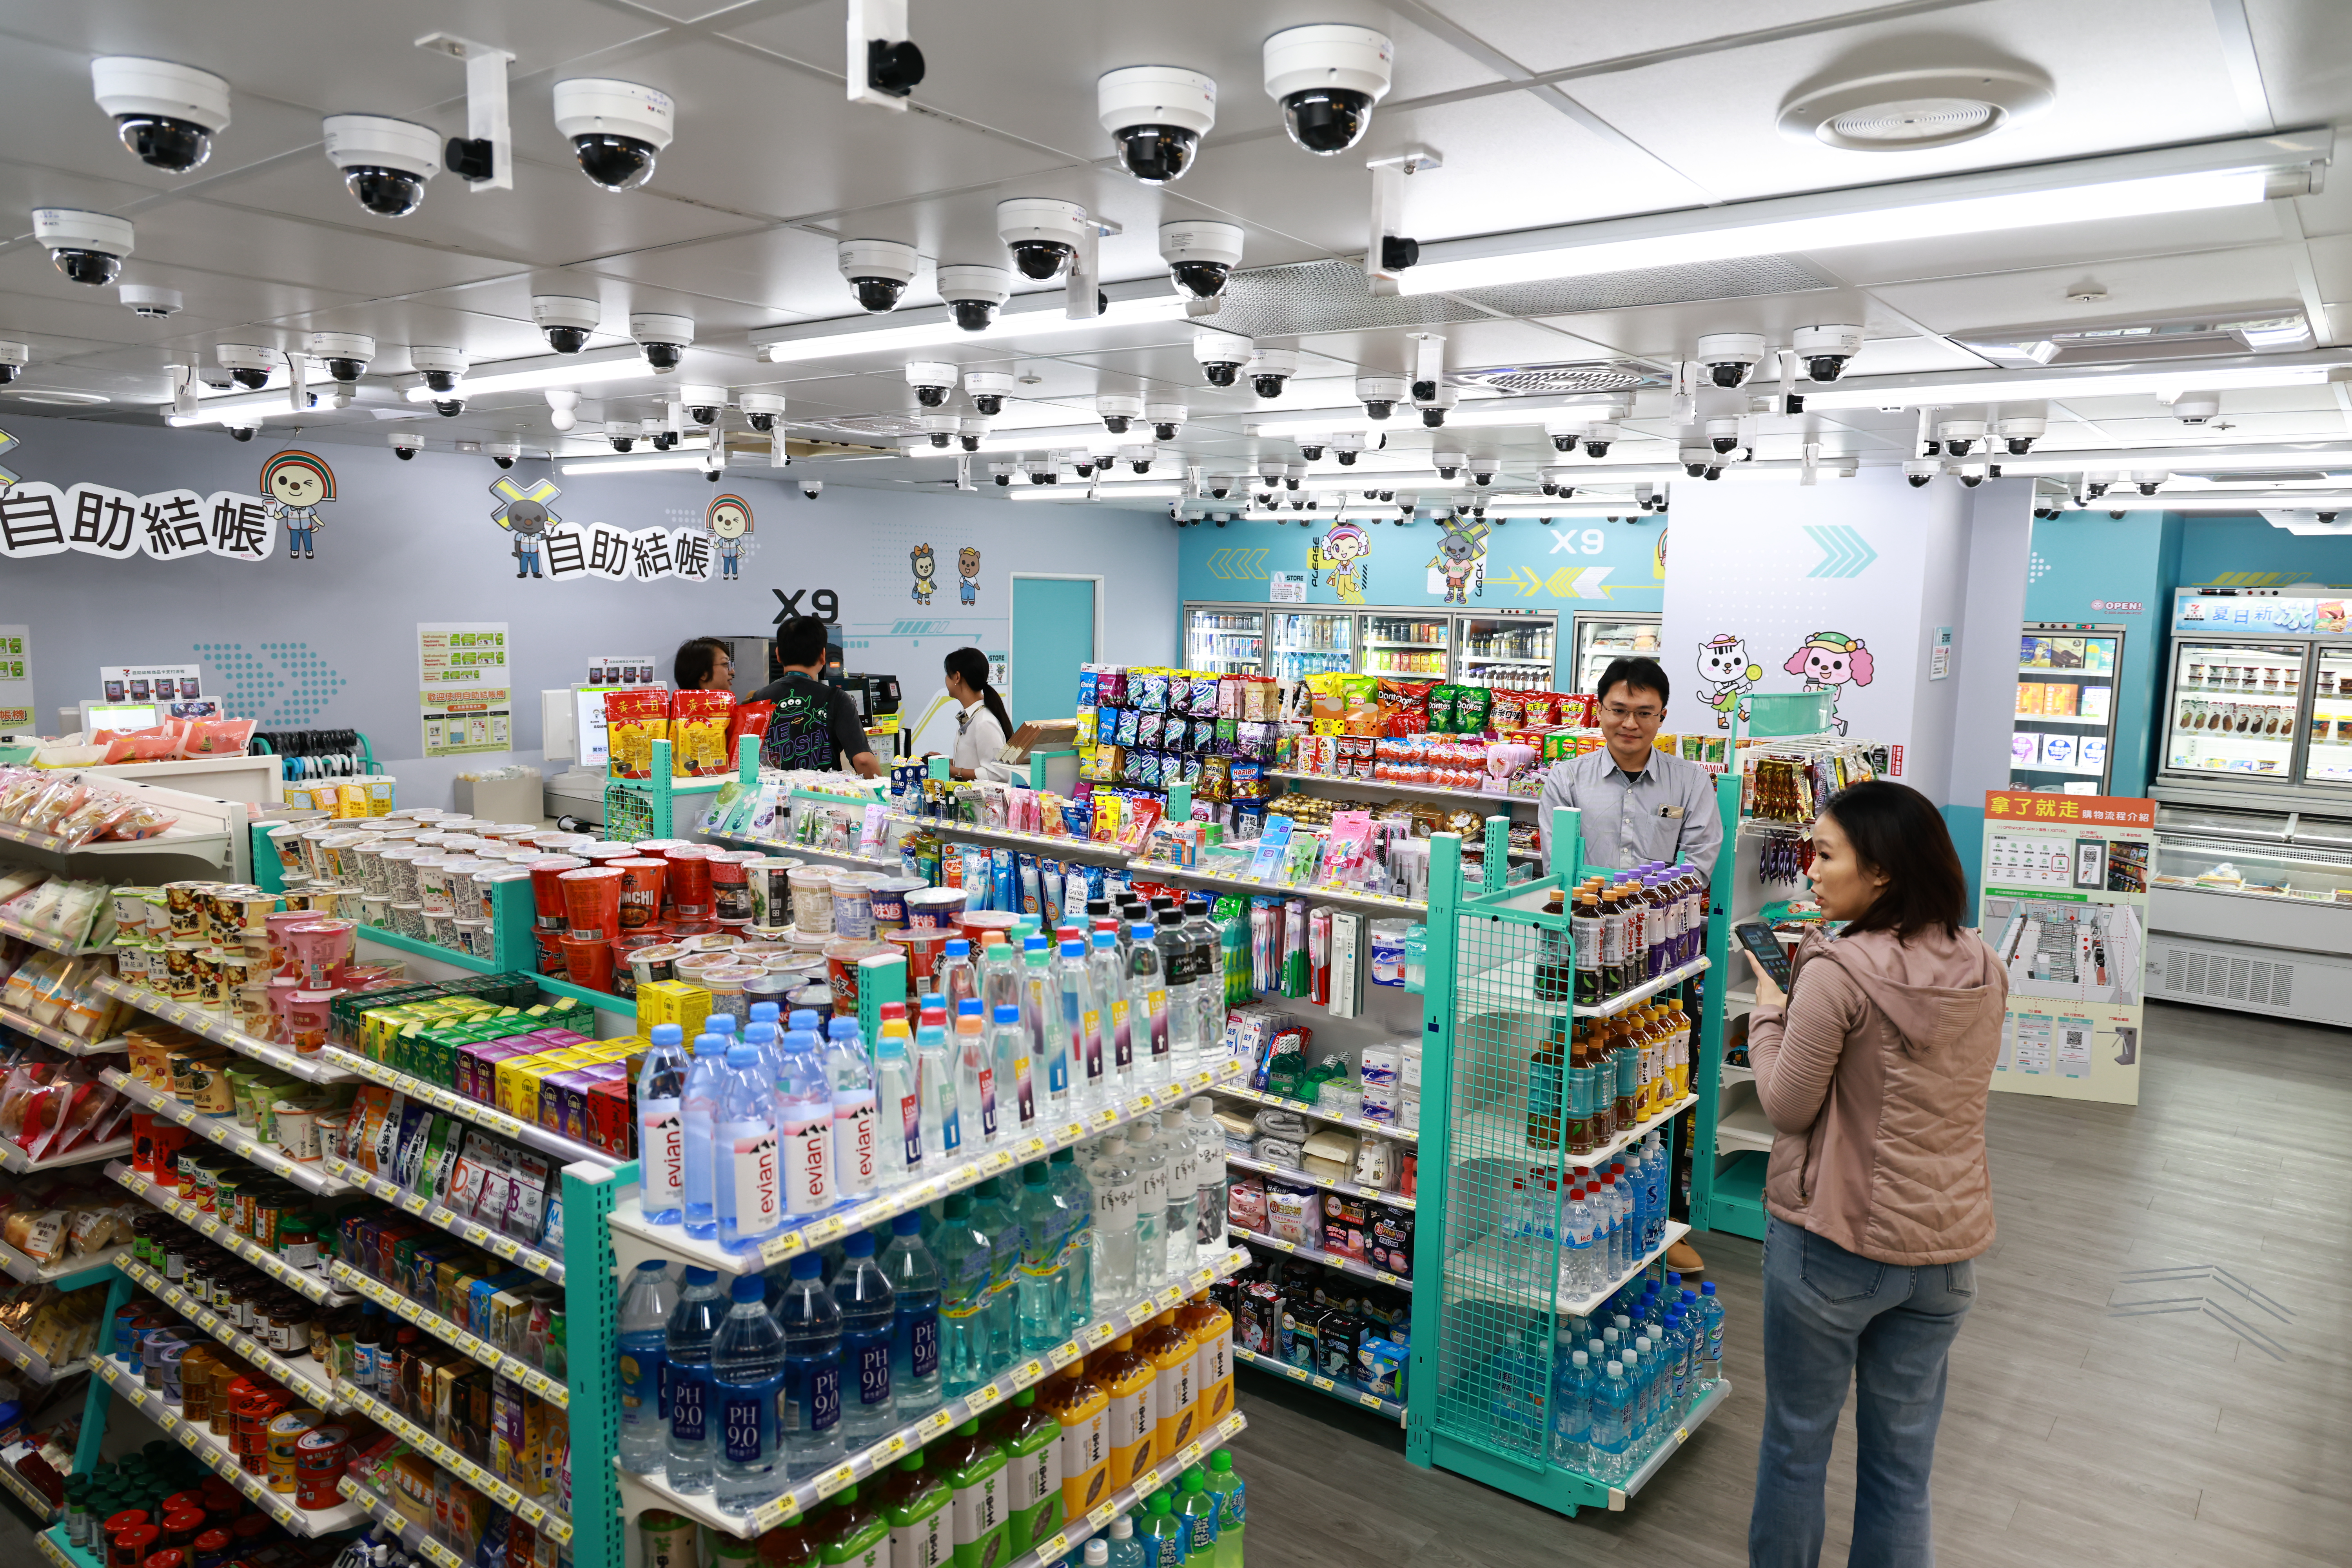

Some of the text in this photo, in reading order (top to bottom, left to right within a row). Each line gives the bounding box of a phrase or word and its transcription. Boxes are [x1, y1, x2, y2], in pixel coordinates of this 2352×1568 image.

[1, 491, 268, 556] 自助結帳
[1549, 529, 1604, 554] X9
[548, 530, 709, 578] 自助結帳
[772, 588, 838, 624] X9
[2105, 601, 2142, 610] OPEN!
[427, 690, 505, 702] 歡迎使用自助結帳機
[687, 698, 729, 711] 黃大目
[1396, 695, 1421, 705] Doritos
[617, 699, 659, 713] 黃大目
[1428, 702, 1451, 711] Doritos
[1457, 701, 1482, 711] Doritos
[1205, 766, 1223, 774] HARIBO
[1991, 796, 2149, 822] 拿了就走 購物流程介紹
[1174, 830, 1194, 840] Nexcare
[623, 873, 639, 892] 辛
[1347, 924, 1355, 937] EX
[1269, 1035, 1280, 1058] Colgate
[857, 1119, 872, 1176] evian
[664, 1129, 681, 1188] evian
[806, 1138, 823, 1195] evian
[758, 1152, 773, 1214] evian
[1269, 1201, 1302, 1216] 超日安褲
[916, 1323, 936, 1344] PH
[864, 1348, 888, 1370] PH
[915, 1344, 937, 1364] 9.0
[863, 1369, 888, 1391] 9.0
[1358, 1367, 1375, 1378] always
[817, 1371, 839, 1394] PH
[987, 1387, 995, 1396] 29
[676, 1386, 700, 1404] PH
[815, 1392, 839, 1417] 9.0
[674, 1405, 702, 1426] 9.0
[730, 1406, 756, 1425] PH
[935, 1413, 946, 1422] 28
[727, 1427, 758, 1448] 9.0
[1105, 1503, 1113, 1512] 32
